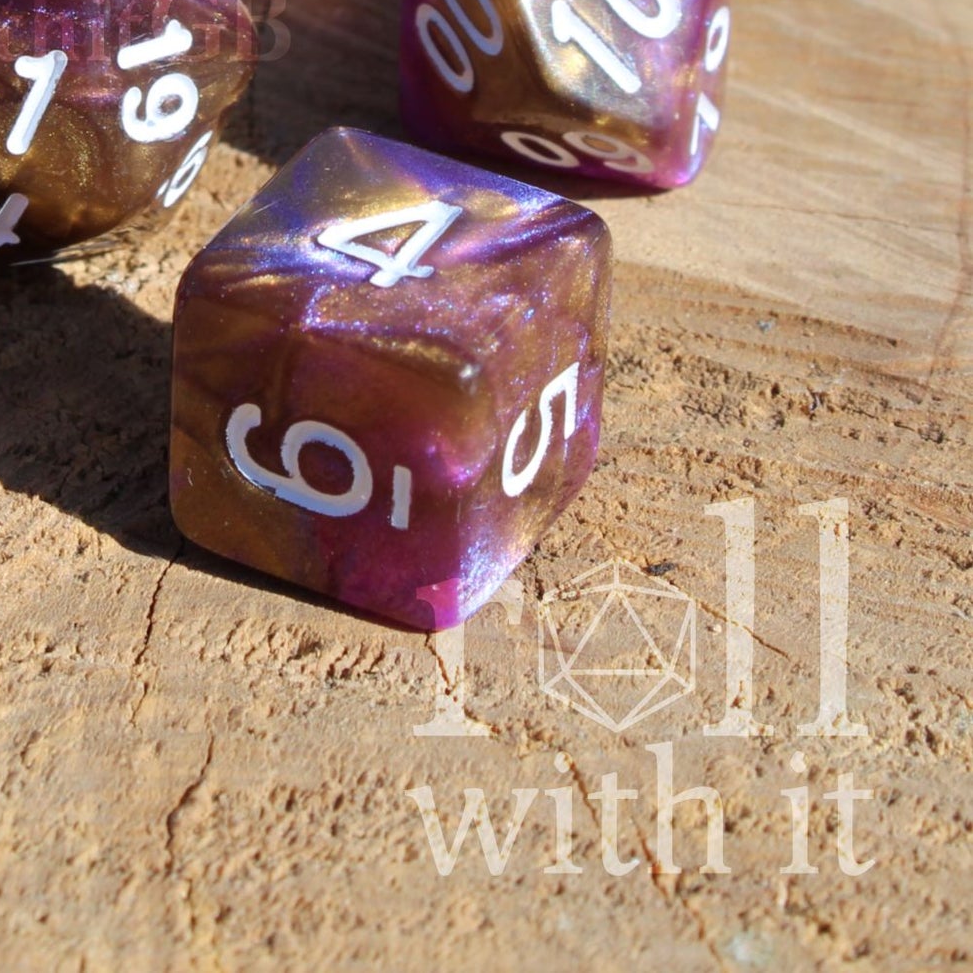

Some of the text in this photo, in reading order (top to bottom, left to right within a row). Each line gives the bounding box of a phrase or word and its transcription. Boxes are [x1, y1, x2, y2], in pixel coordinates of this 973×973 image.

[6, 50, 68, 155] 1
[117, 19, 200, 143] 19
[317, 200, 463, 288] 4
[501, 361, 580, 498] 5
